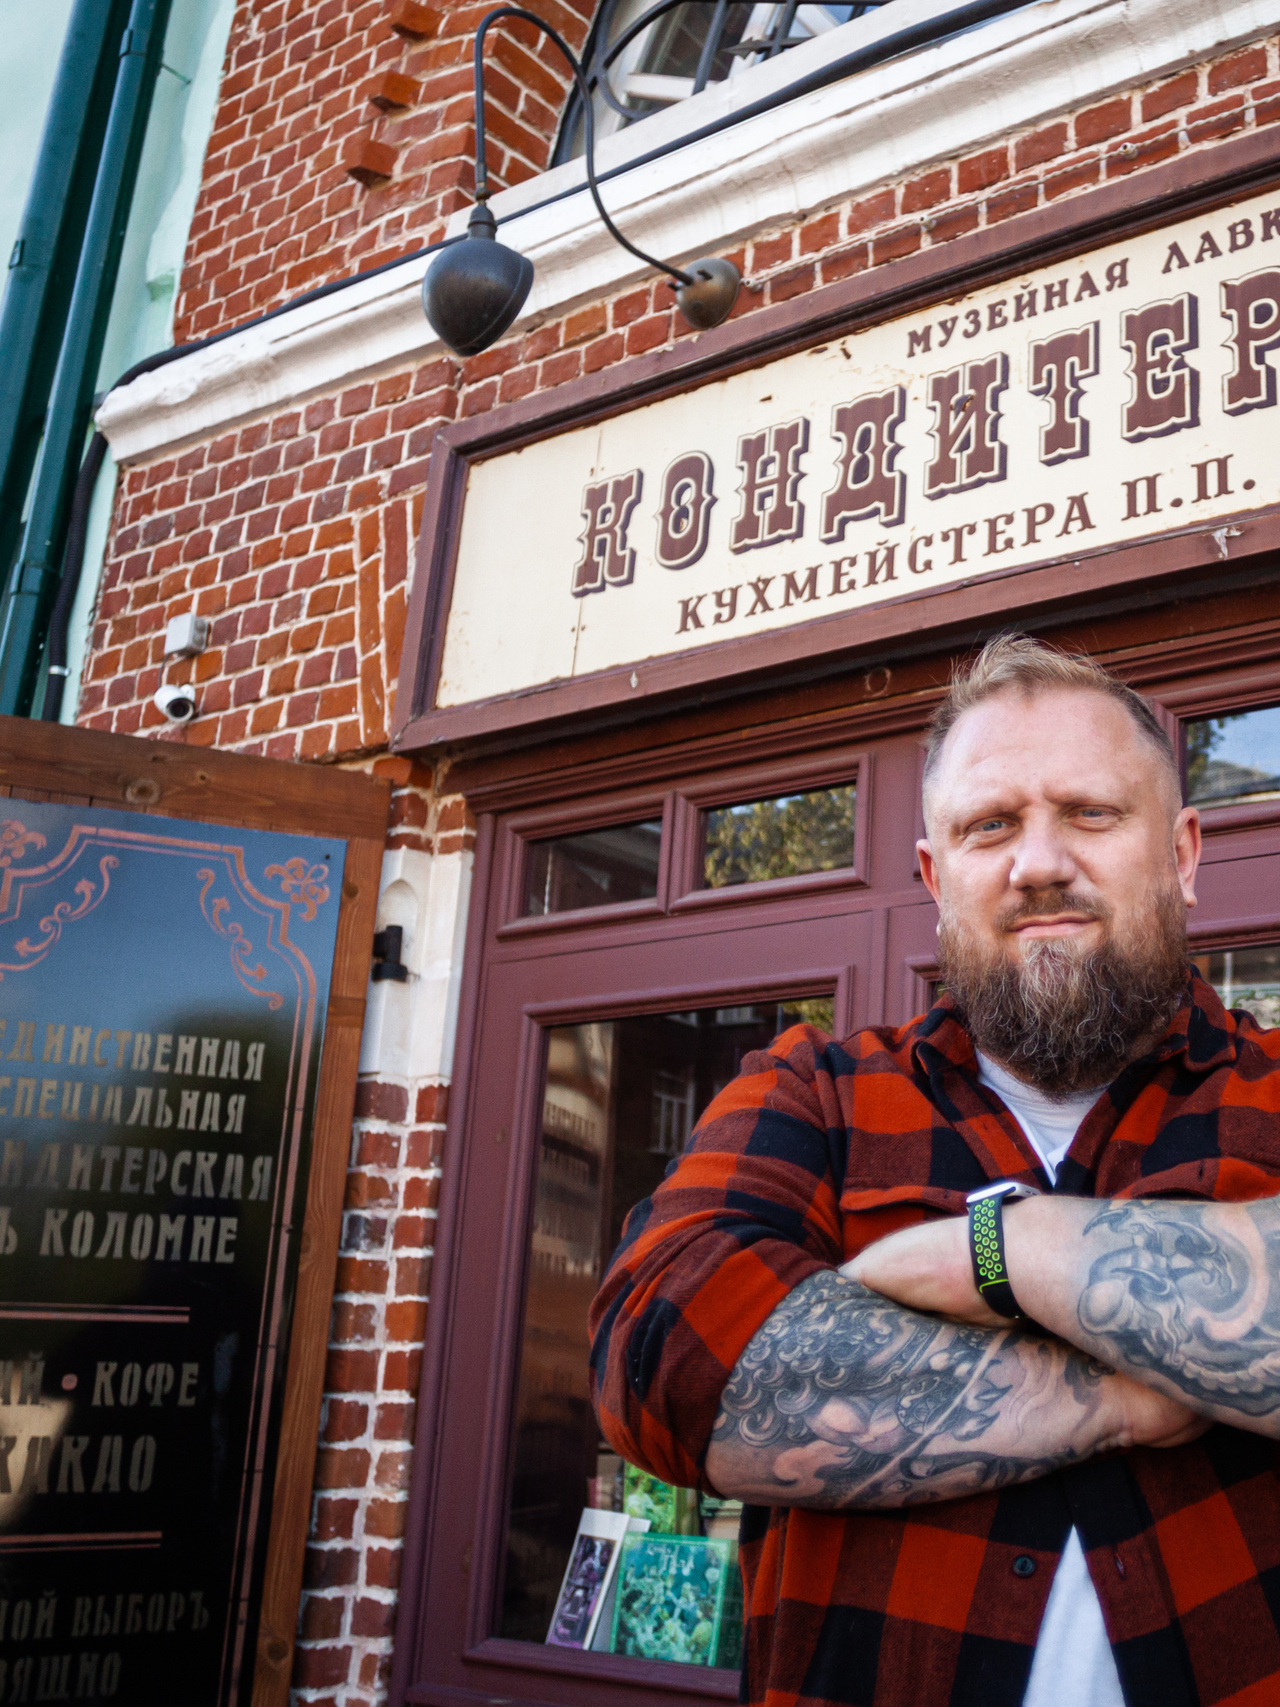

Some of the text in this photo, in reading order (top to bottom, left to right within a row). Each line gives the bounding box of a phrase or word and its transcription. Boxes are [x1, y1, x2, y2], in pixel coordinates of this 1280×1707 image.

[906, 257, 1131, 359] МУЗЕЙНАЯ
[676, 492, 1097, 636] КУХМЕЙСТЕРА
[1120, 452, 1257, 523] П.П.
[39, 1209, 239, 1265] КОЛОМНЕ
[90, 1360, 200, 1408] КОФЕ
